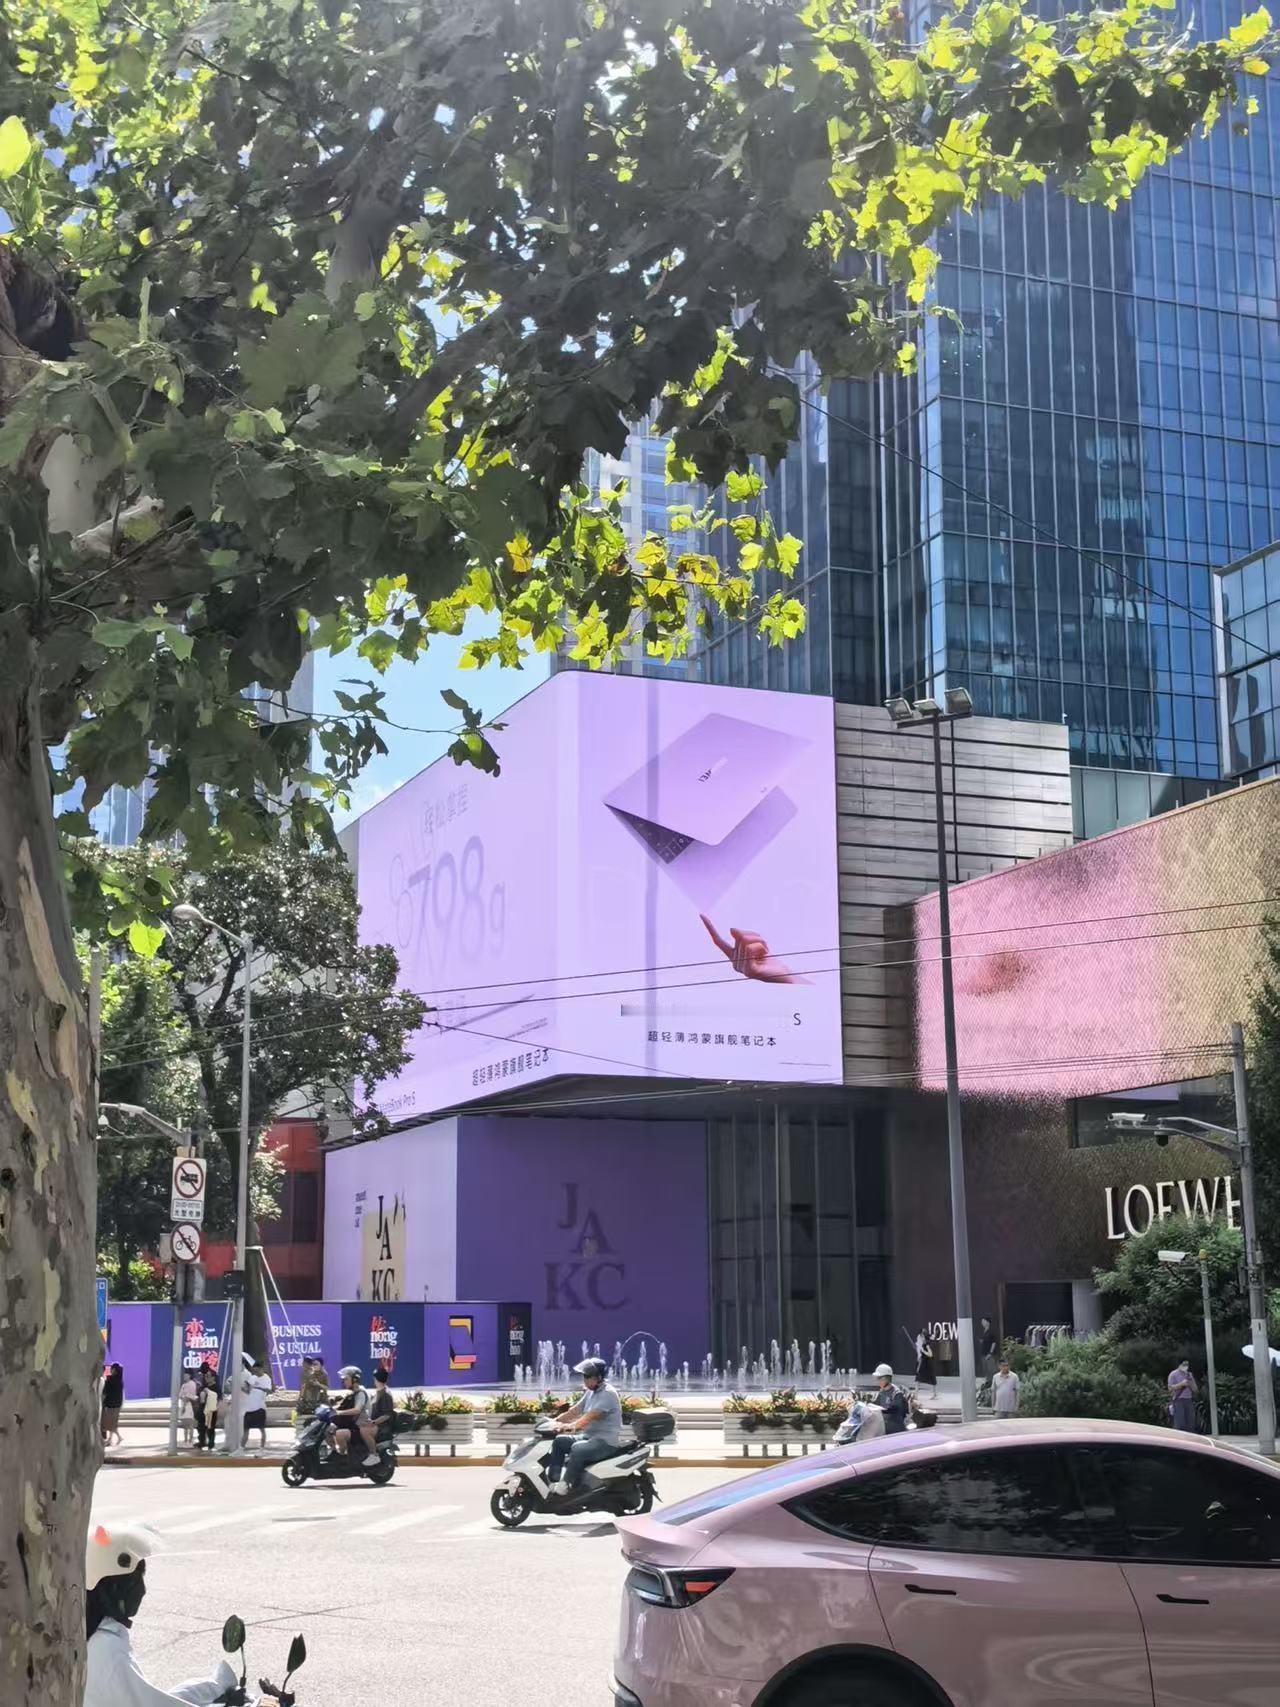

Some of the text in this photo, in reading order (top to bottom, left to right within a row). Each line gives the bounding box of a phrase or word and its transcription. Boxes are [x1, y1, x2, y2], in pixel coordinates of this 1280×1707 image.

[793, 1012, 802, 1026] S
[647, 1030, 777, 1047] 超轻薄鸿蒙旗舰笔记本
[271, 1325, 322, 1338] BUSINESS
[928, 1321, 958, 1340] LOEW
[271, 1342, 322, 1355] AS USUAL
